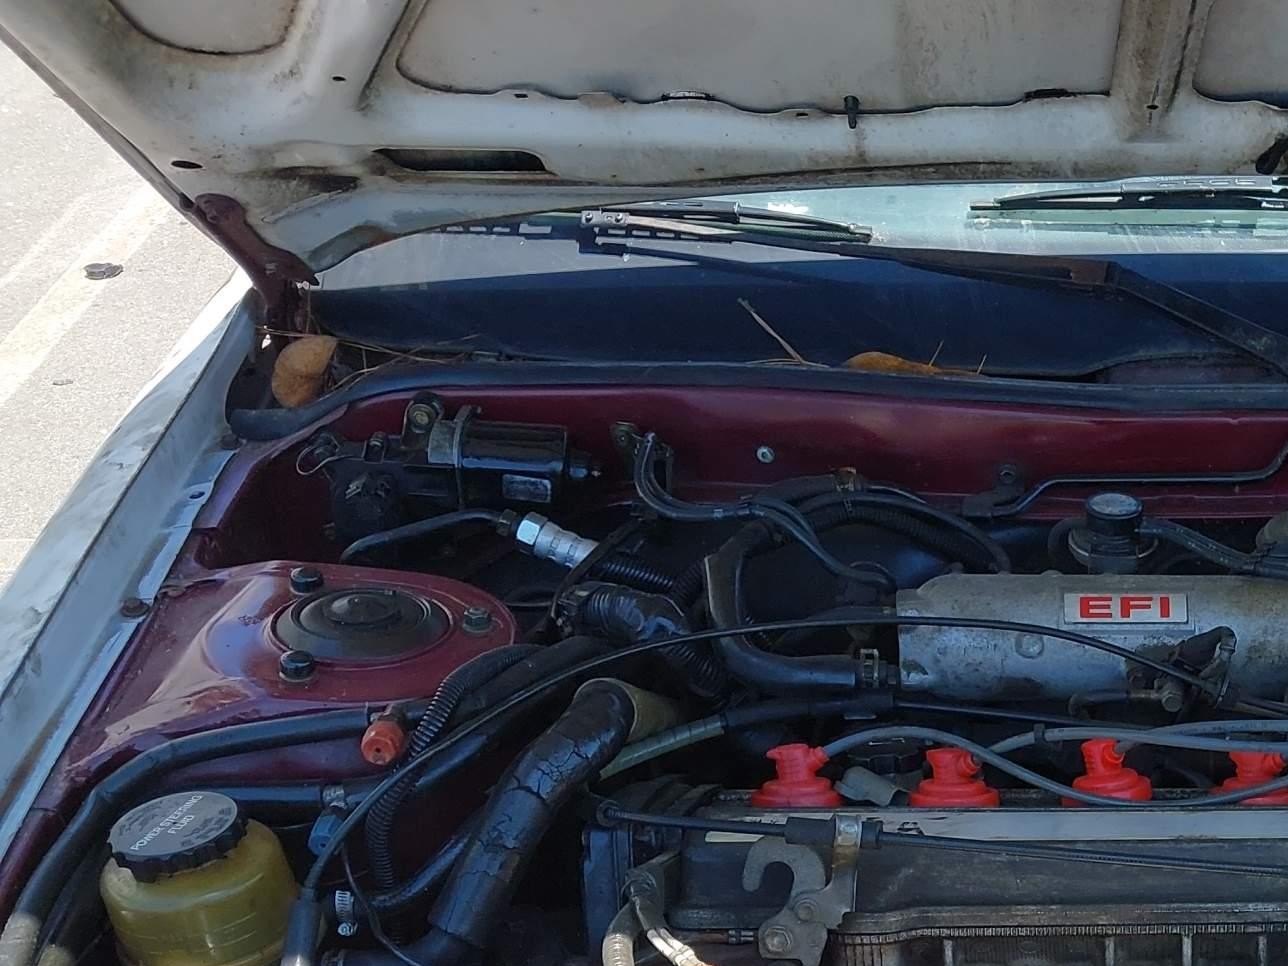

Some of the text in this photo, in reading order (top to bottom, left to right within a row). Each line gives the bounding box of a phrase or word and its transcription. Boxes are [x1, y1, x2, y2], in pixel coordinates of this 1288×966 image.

[1079, 596, 1171, 619] EFI
[130, 827, 161, 851] POWER
[160, 795, 204, 828] STEERING
[167, 814, 195, 834] FLUID
